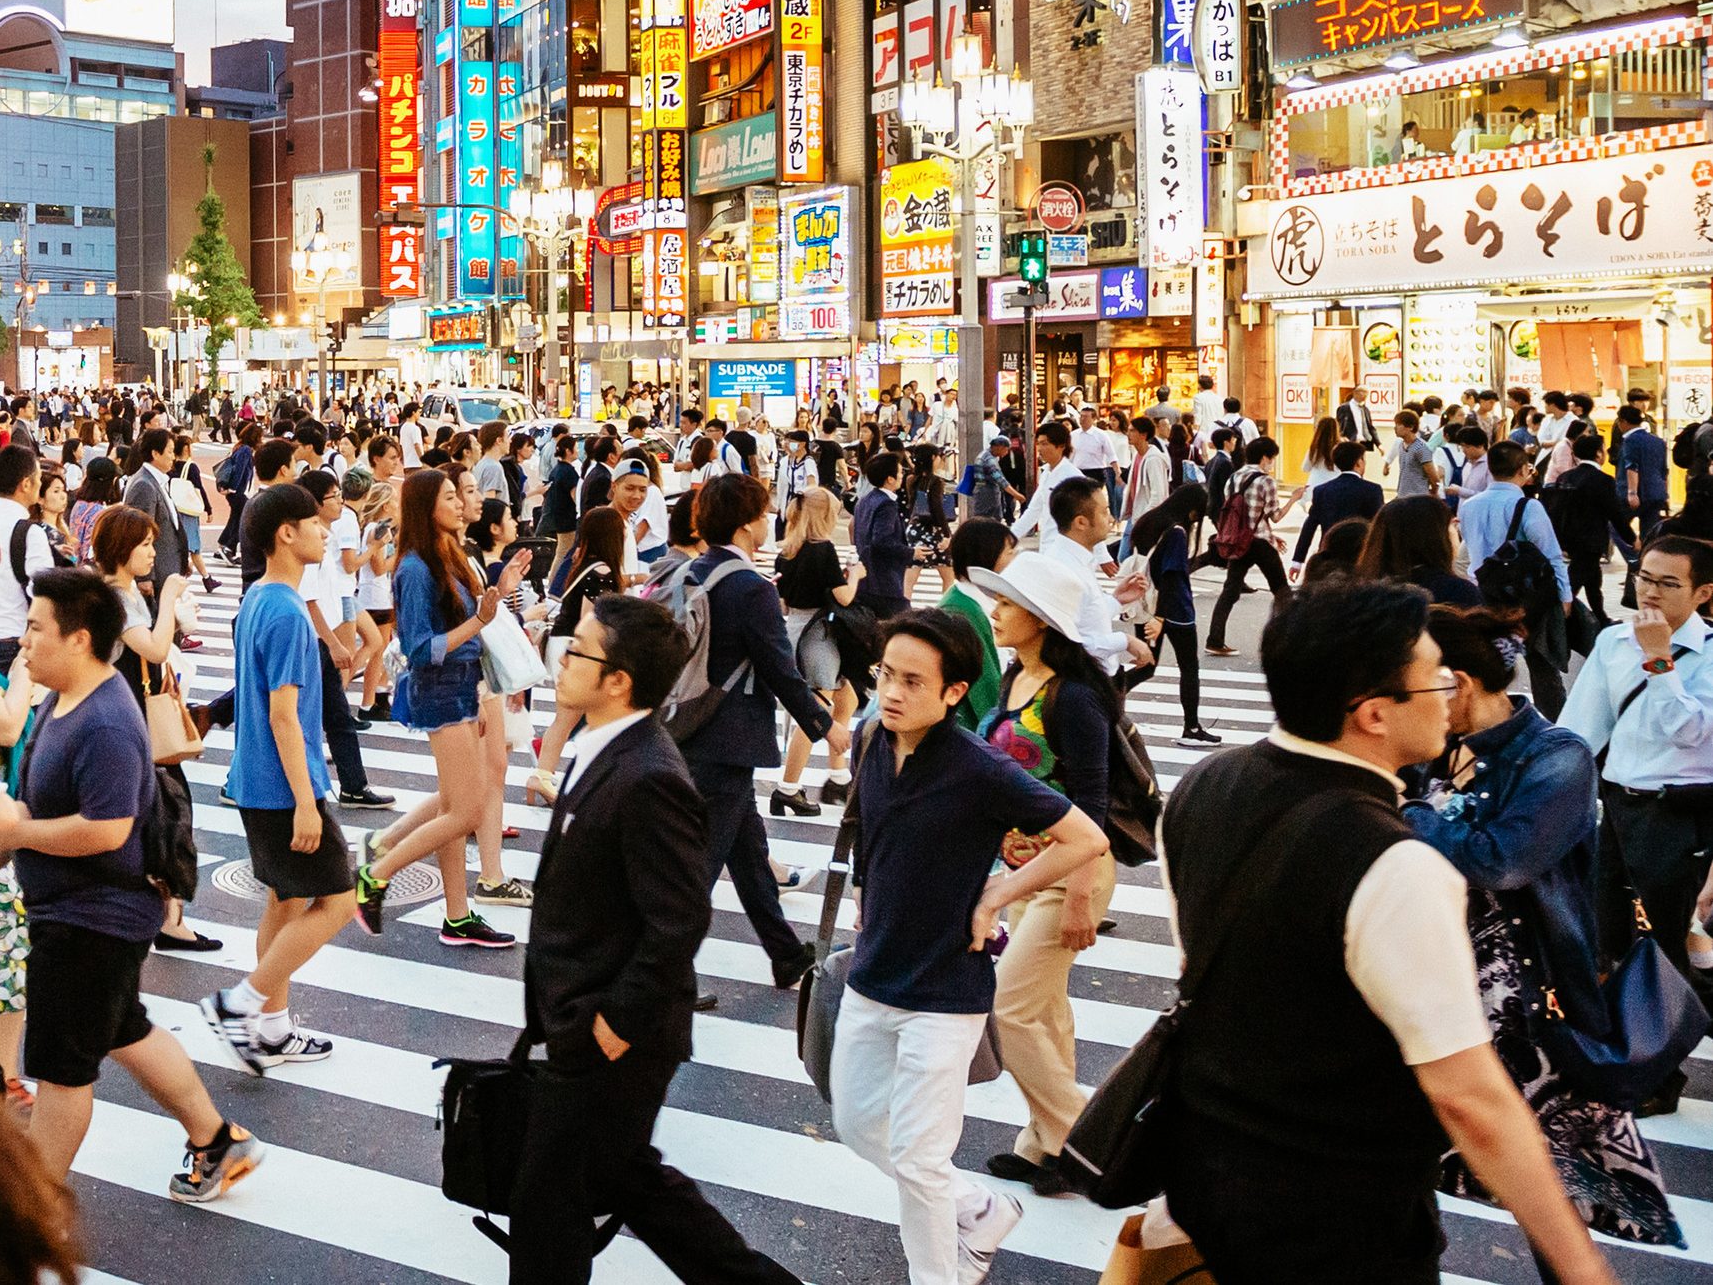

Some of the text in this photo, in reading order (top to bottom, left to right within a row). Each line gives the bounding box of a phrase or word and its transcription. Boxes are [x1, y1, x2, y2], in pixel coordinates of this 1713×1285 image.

[790, 21, 814, 40] 2F
[1211, 0, 1235, 62] かっぱ
[1213, 69, 1234, 83] B1
[578, 82, 624, 98] DOUTOR
[878, 91, 896, 111] 3F
[388, 73, 415, 174] パチンコ
[787, 53, 805, 171] 東京チカラめし
[466, 74, 490, 279] カラオケ館
[660, 131, 683, 199] お好み焼
[1159, 113, 1184, 232] とらそば
[903, 188, 952, 233] 金の蔵
[1041, 202, 1074, 218] 消火栓
[1412, 164, 1666, 265] とらそば
[388, 185, 417, 290] エパス
[794, 208, 840, 242] まんが
[1276, 205, 1318, 279] 虎
[1336, 243, 1398, 259] TORA SOBA
[1610, 253, 1637, 265] UDON
[1646, 250, 1671, 262] SOBA
[718, 363, 786, 376] SUBNADE
[1285, 388, 1310, 405] OK!
[1369, 388, 1397, 405] OK!
[716, 403, 730, 421] 5
